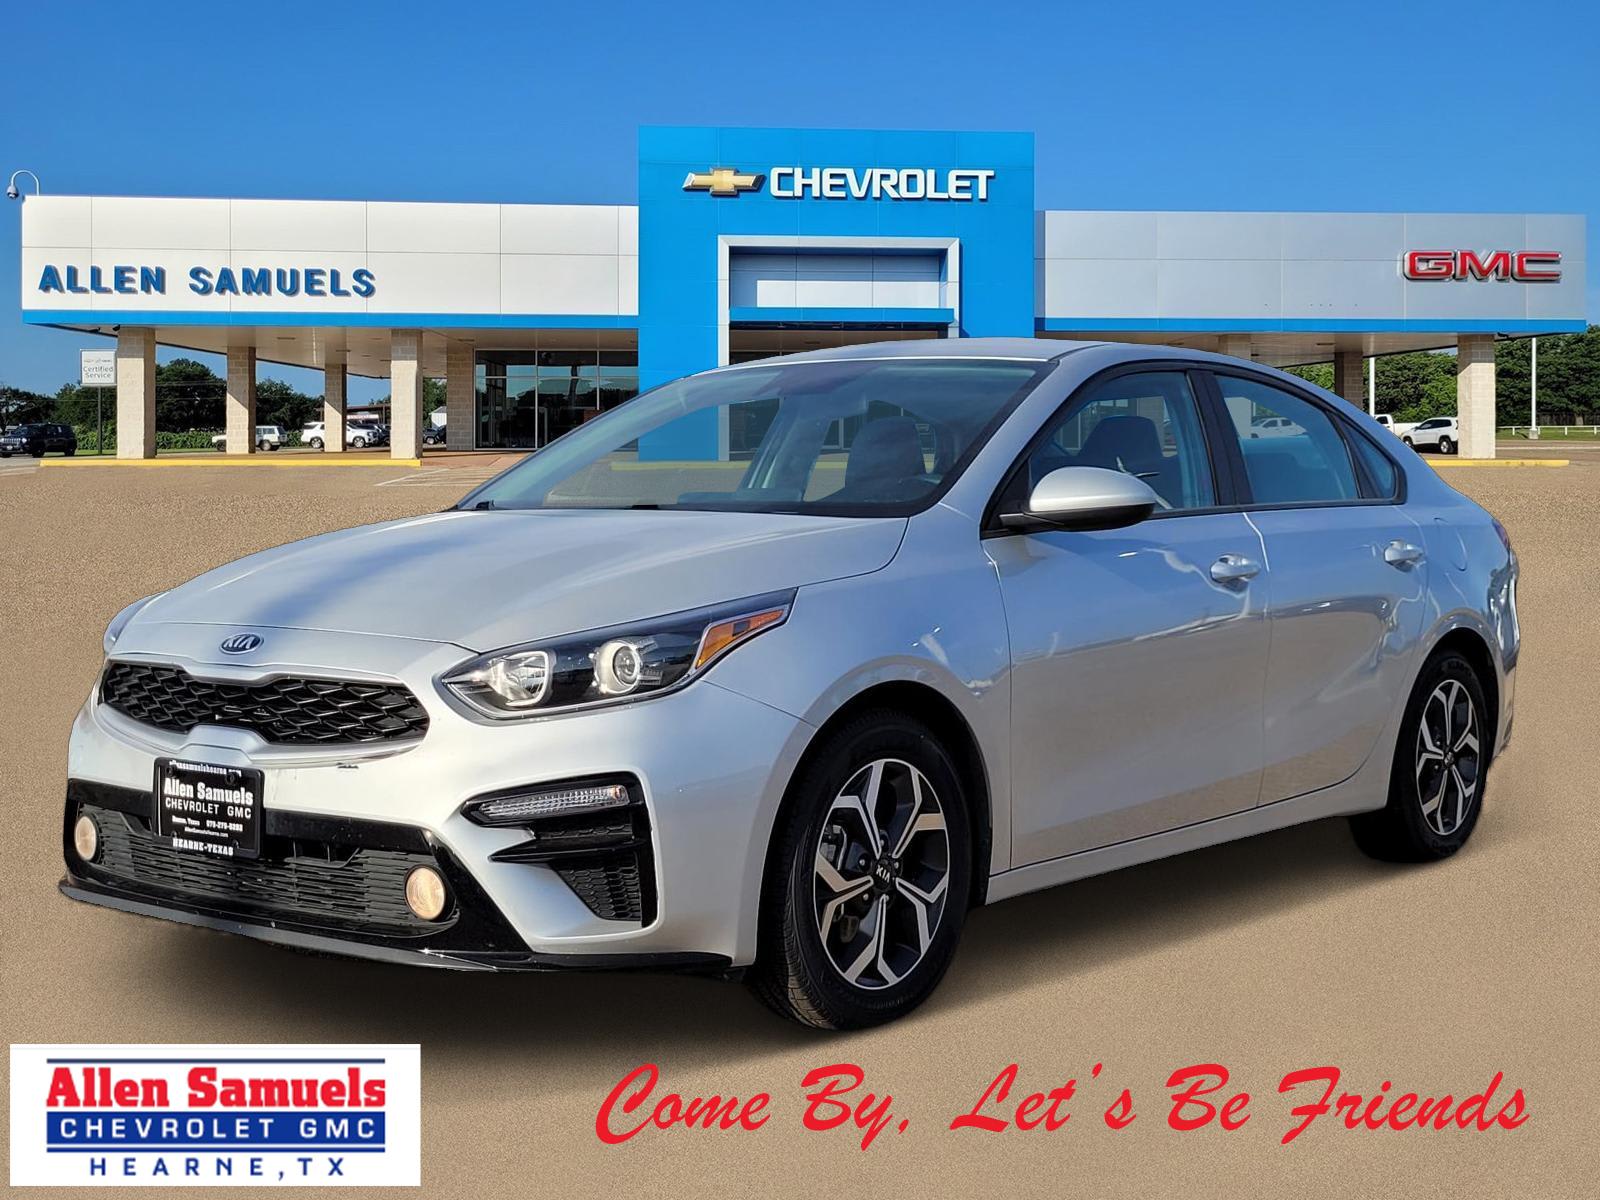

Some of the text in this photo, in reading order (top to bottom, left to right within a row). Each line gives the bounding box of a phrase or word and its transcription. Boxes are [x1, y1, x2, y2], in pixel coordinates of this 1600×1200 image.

[770, 167, 995, 200] CHEVROLET
[1403, 249, 1562, 281] GMC
[39, 264, 376, 297] ALLEN SAMUELS
[223, 634, 255, 649] KIA
[164, 777, 254, 806] Allen Samuels
[165, 797, 252, 819] CHEVROLET GMC
[875, 864, 891, 884] KIA
